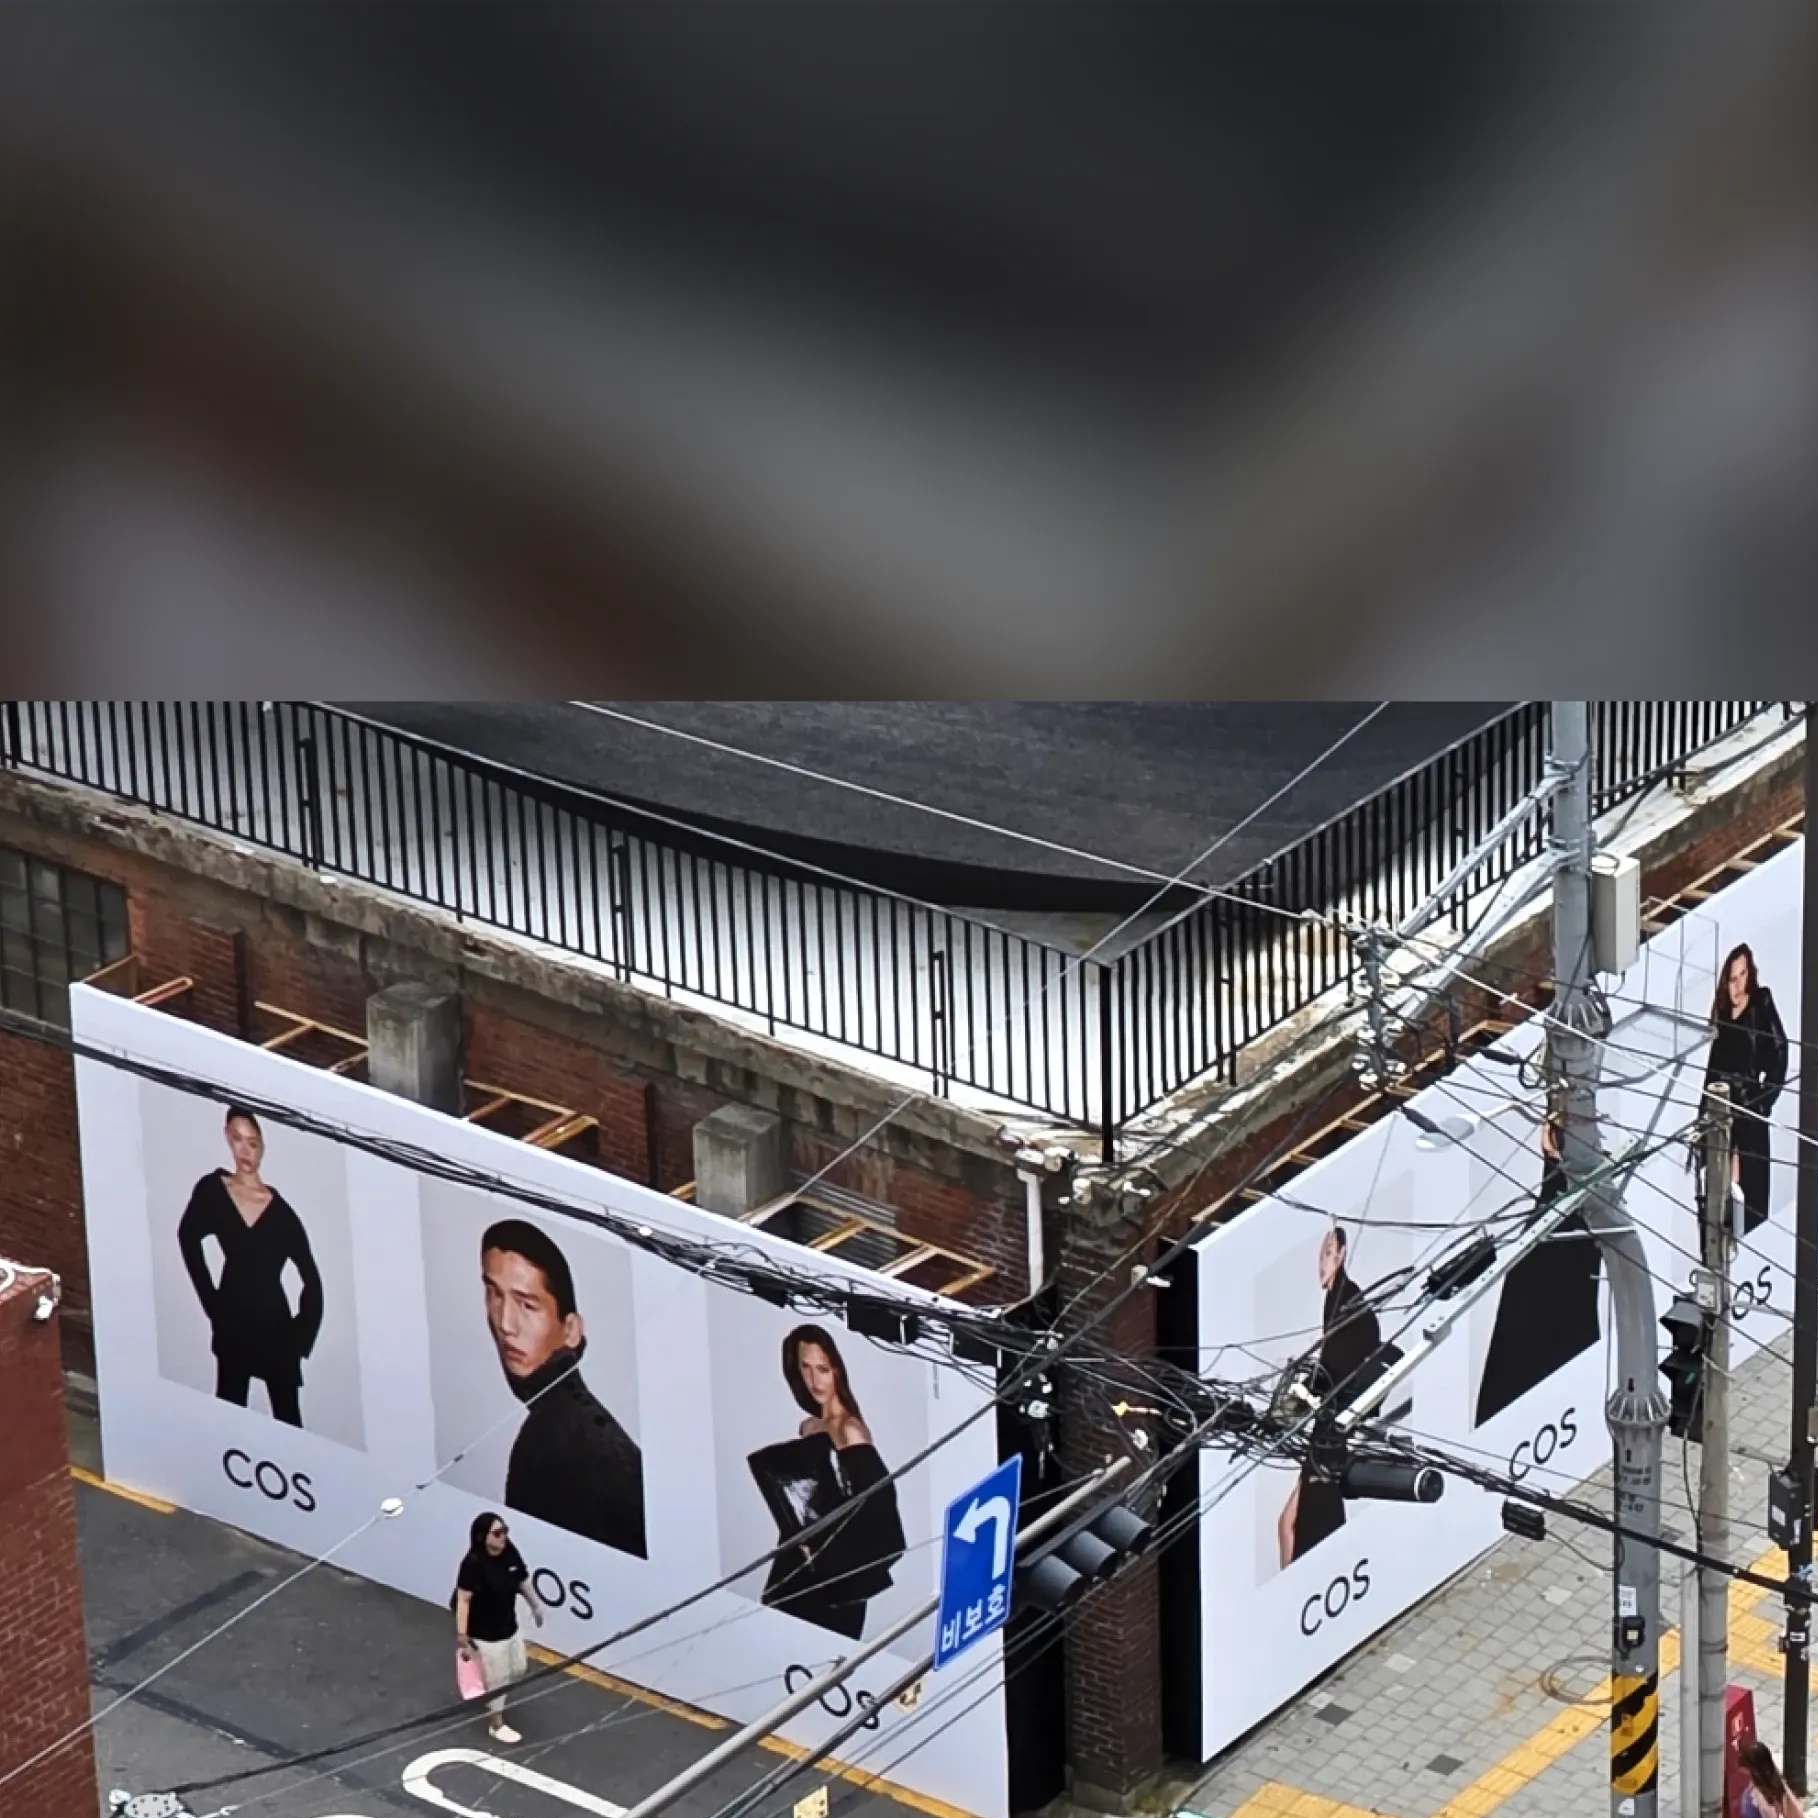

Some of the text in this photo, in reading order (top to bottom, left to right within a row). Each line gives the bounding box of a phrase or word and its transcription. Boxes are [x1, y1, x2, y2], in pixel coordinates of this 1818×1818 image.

[1732, 1266, 1773, 1320] OS
[1508, 1407, 1577, 1481] COS
[222, 1448, 317, 1512] COS
[533, 1567, 594, 1620] OS
[940, 1582, 1007, 1656] 비보호
[1300, 1557, 1370, 1637] COS
